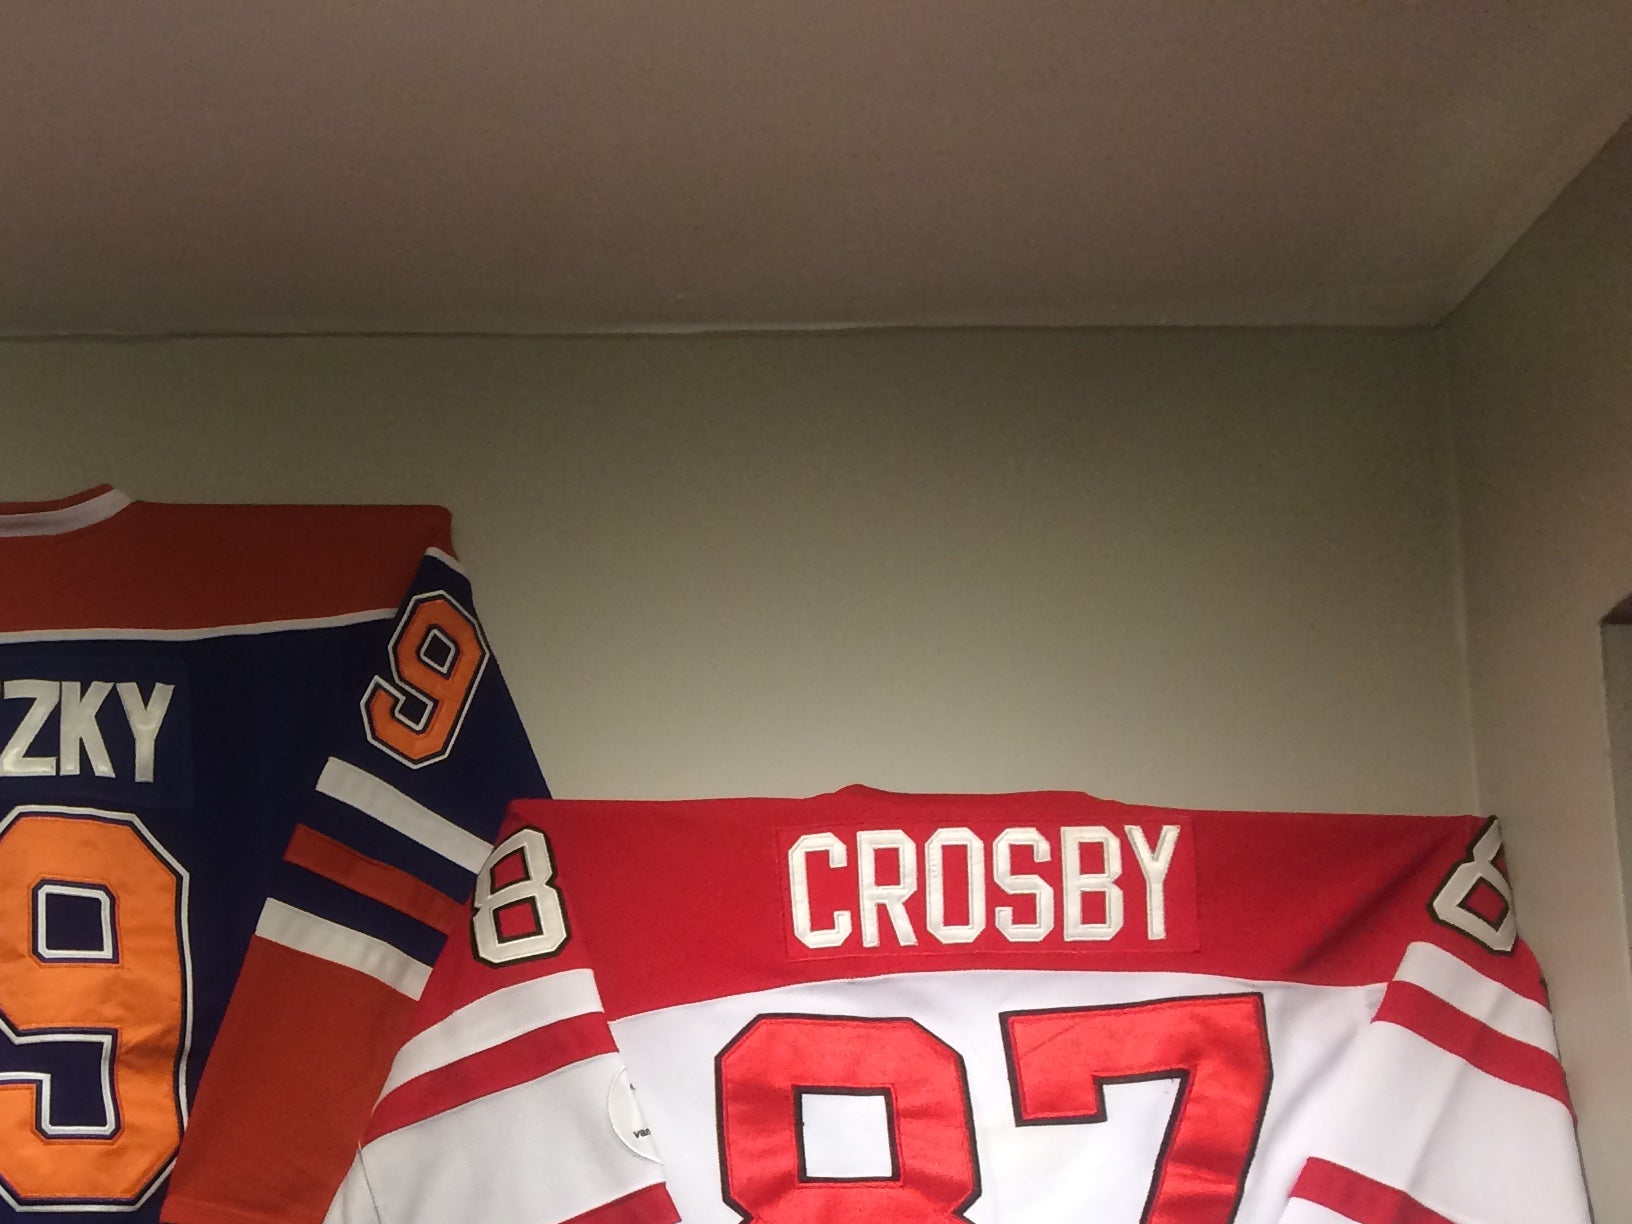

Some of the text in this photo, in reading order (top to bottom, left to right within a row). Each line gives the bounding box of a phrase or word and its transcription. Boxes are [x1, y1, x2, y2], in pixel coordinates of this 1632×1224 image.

[360, 589, 490, 771] 9
[470, 823, 571, 968] 8
[787, 825, 1182, 949] CROSBY
